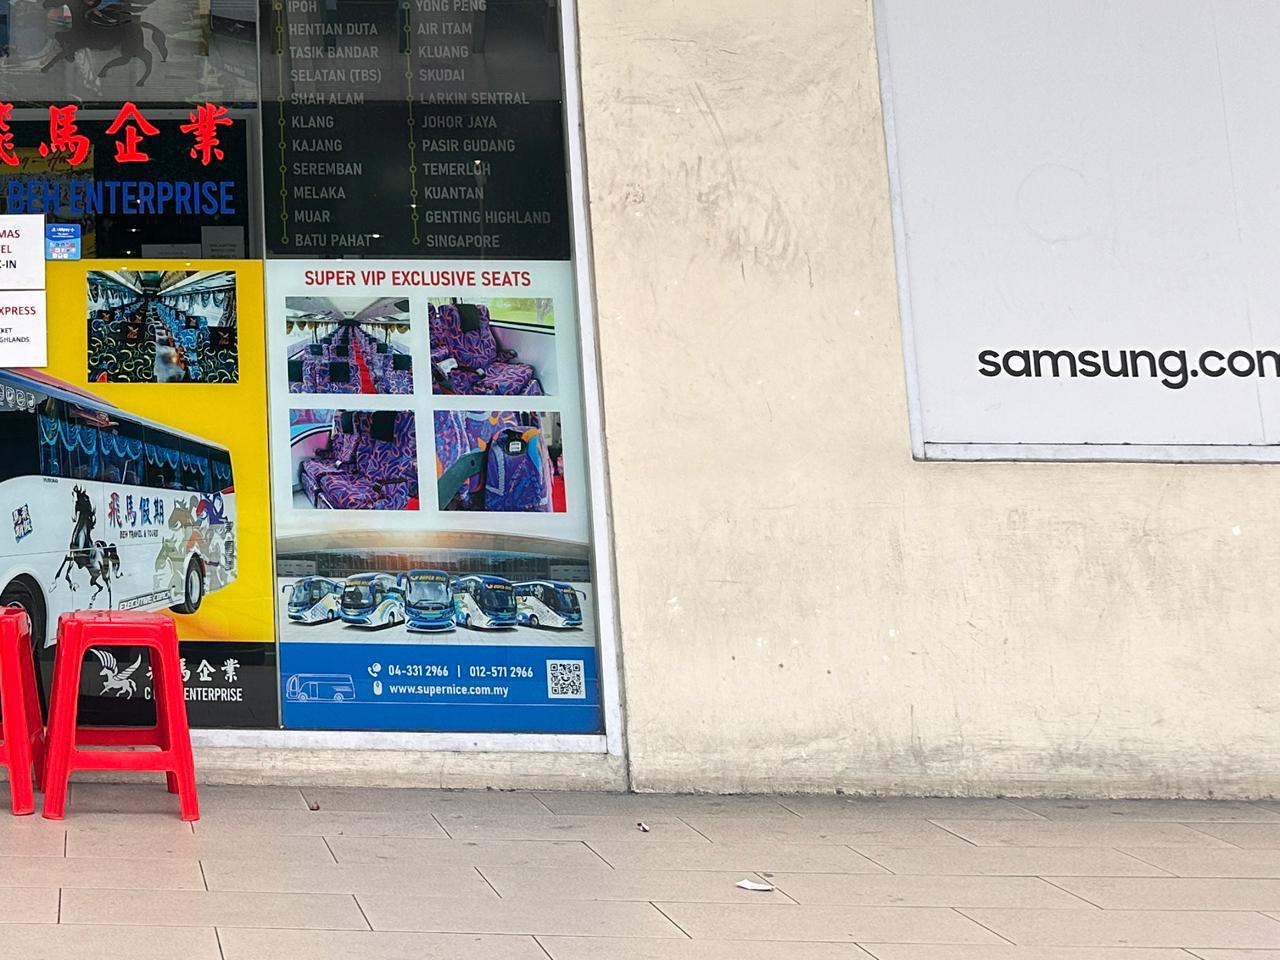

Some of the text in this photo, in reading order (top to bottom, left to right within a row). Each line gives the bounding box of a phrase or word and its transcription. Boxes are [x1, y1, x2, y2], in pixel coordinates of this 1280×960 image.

[289, 0, 317, 13] IPOH
[416, 0, 487, 12] YONG PENG
[289, 23, 378, 35] HENTIAN DUTA
[417, 22, 472, 35] AIR ITAM
[289, 46, 379, 59] TASIK BANDAR
[419, 46, 469, 58] KLUANG
[291, 69, 381, 83] SELATAN (TBS)
[419, 69, 464, 81] SKUDAI
[291, 92, 364, 105] SHAH ALAM
[421, 92, 530, 104] LARKIN SENTRAL
[291, 116, 334, 128] KLANG
[421, 116, 497, 128] JOHOR JAYA
[292, 139, 342, 152] KAJANG
[422, 139, 515, 152] PASIR GUDANG
[293, 163, 362, 176] SEREMBAN
[423, 163, 491, 176] TEMERLOH
[8, 181, 60, 215] BEH
[71, 181, 235, 215] ENTERPRISE
[294, 186, 346, 199] MELAKA
[424, 186, 484, 199] KUANTAN
[294, 210, 330, 223] MUAR
[426, 210, 551, 224] GENTING HIGHLAND
[295, 234, 371, 247] BATU PAHAT
[426, 234, 500, 248] SINGAPORE
[304, 271, 531, 286] SUPER VIP EXCLUSIVE SEATS
[108, 492, 165, 529] 飛馬假期
[388, 665, 533, 678] 04-331 2966 012-571 2966
[184, 687, 243, 701] ENTERPRISE
[389, 683, 509, 697] www.supernice.com.my
